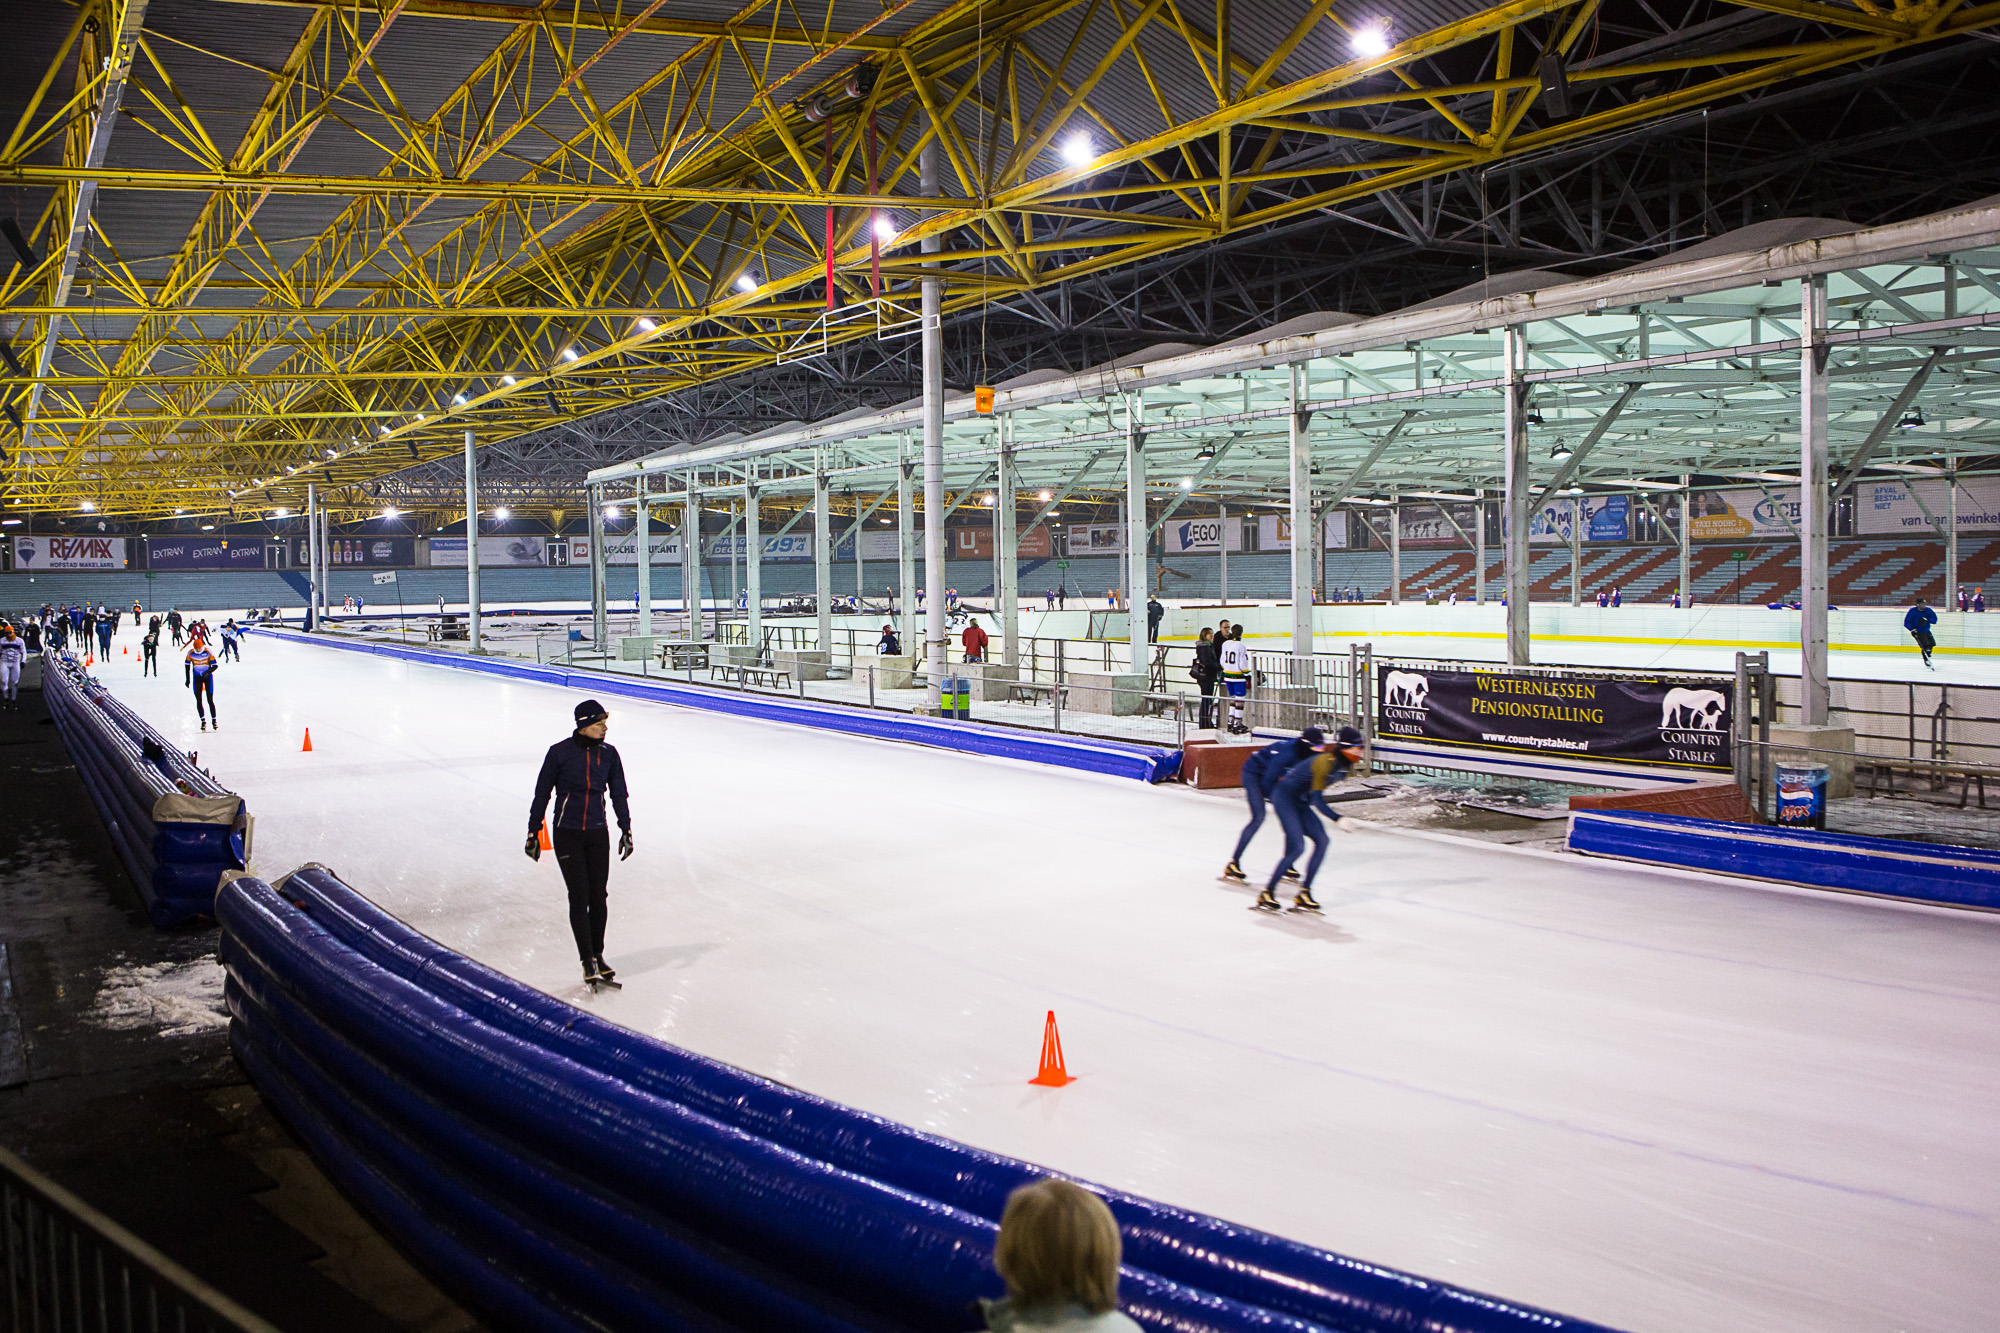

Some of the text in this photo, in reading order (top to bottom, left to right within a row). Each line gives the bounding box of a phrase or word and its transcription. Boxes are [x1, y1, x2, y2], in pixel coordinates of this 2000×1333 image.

[1875, 494, 1906, 502] BESTAAT
[1875, 502, 1891, 510] NIET
[1902, 517, 1921, 526] van
[153, 546, 260, 558] EXTRAN EXTRAN EXTRAN
[1225, 651, 1237, 664] 10
[1385, 707, 1427, 721] COUNTRY
[1389, 721, 1423, 735] STABLES
[1482, 733, 1589, 750] www.countrystables.nl
[1661, 731, 1722, 746] COUNTRY
[1668, 748, 1716, 763] STABLES
[1779, 773, 1816, 784] PEPSI
